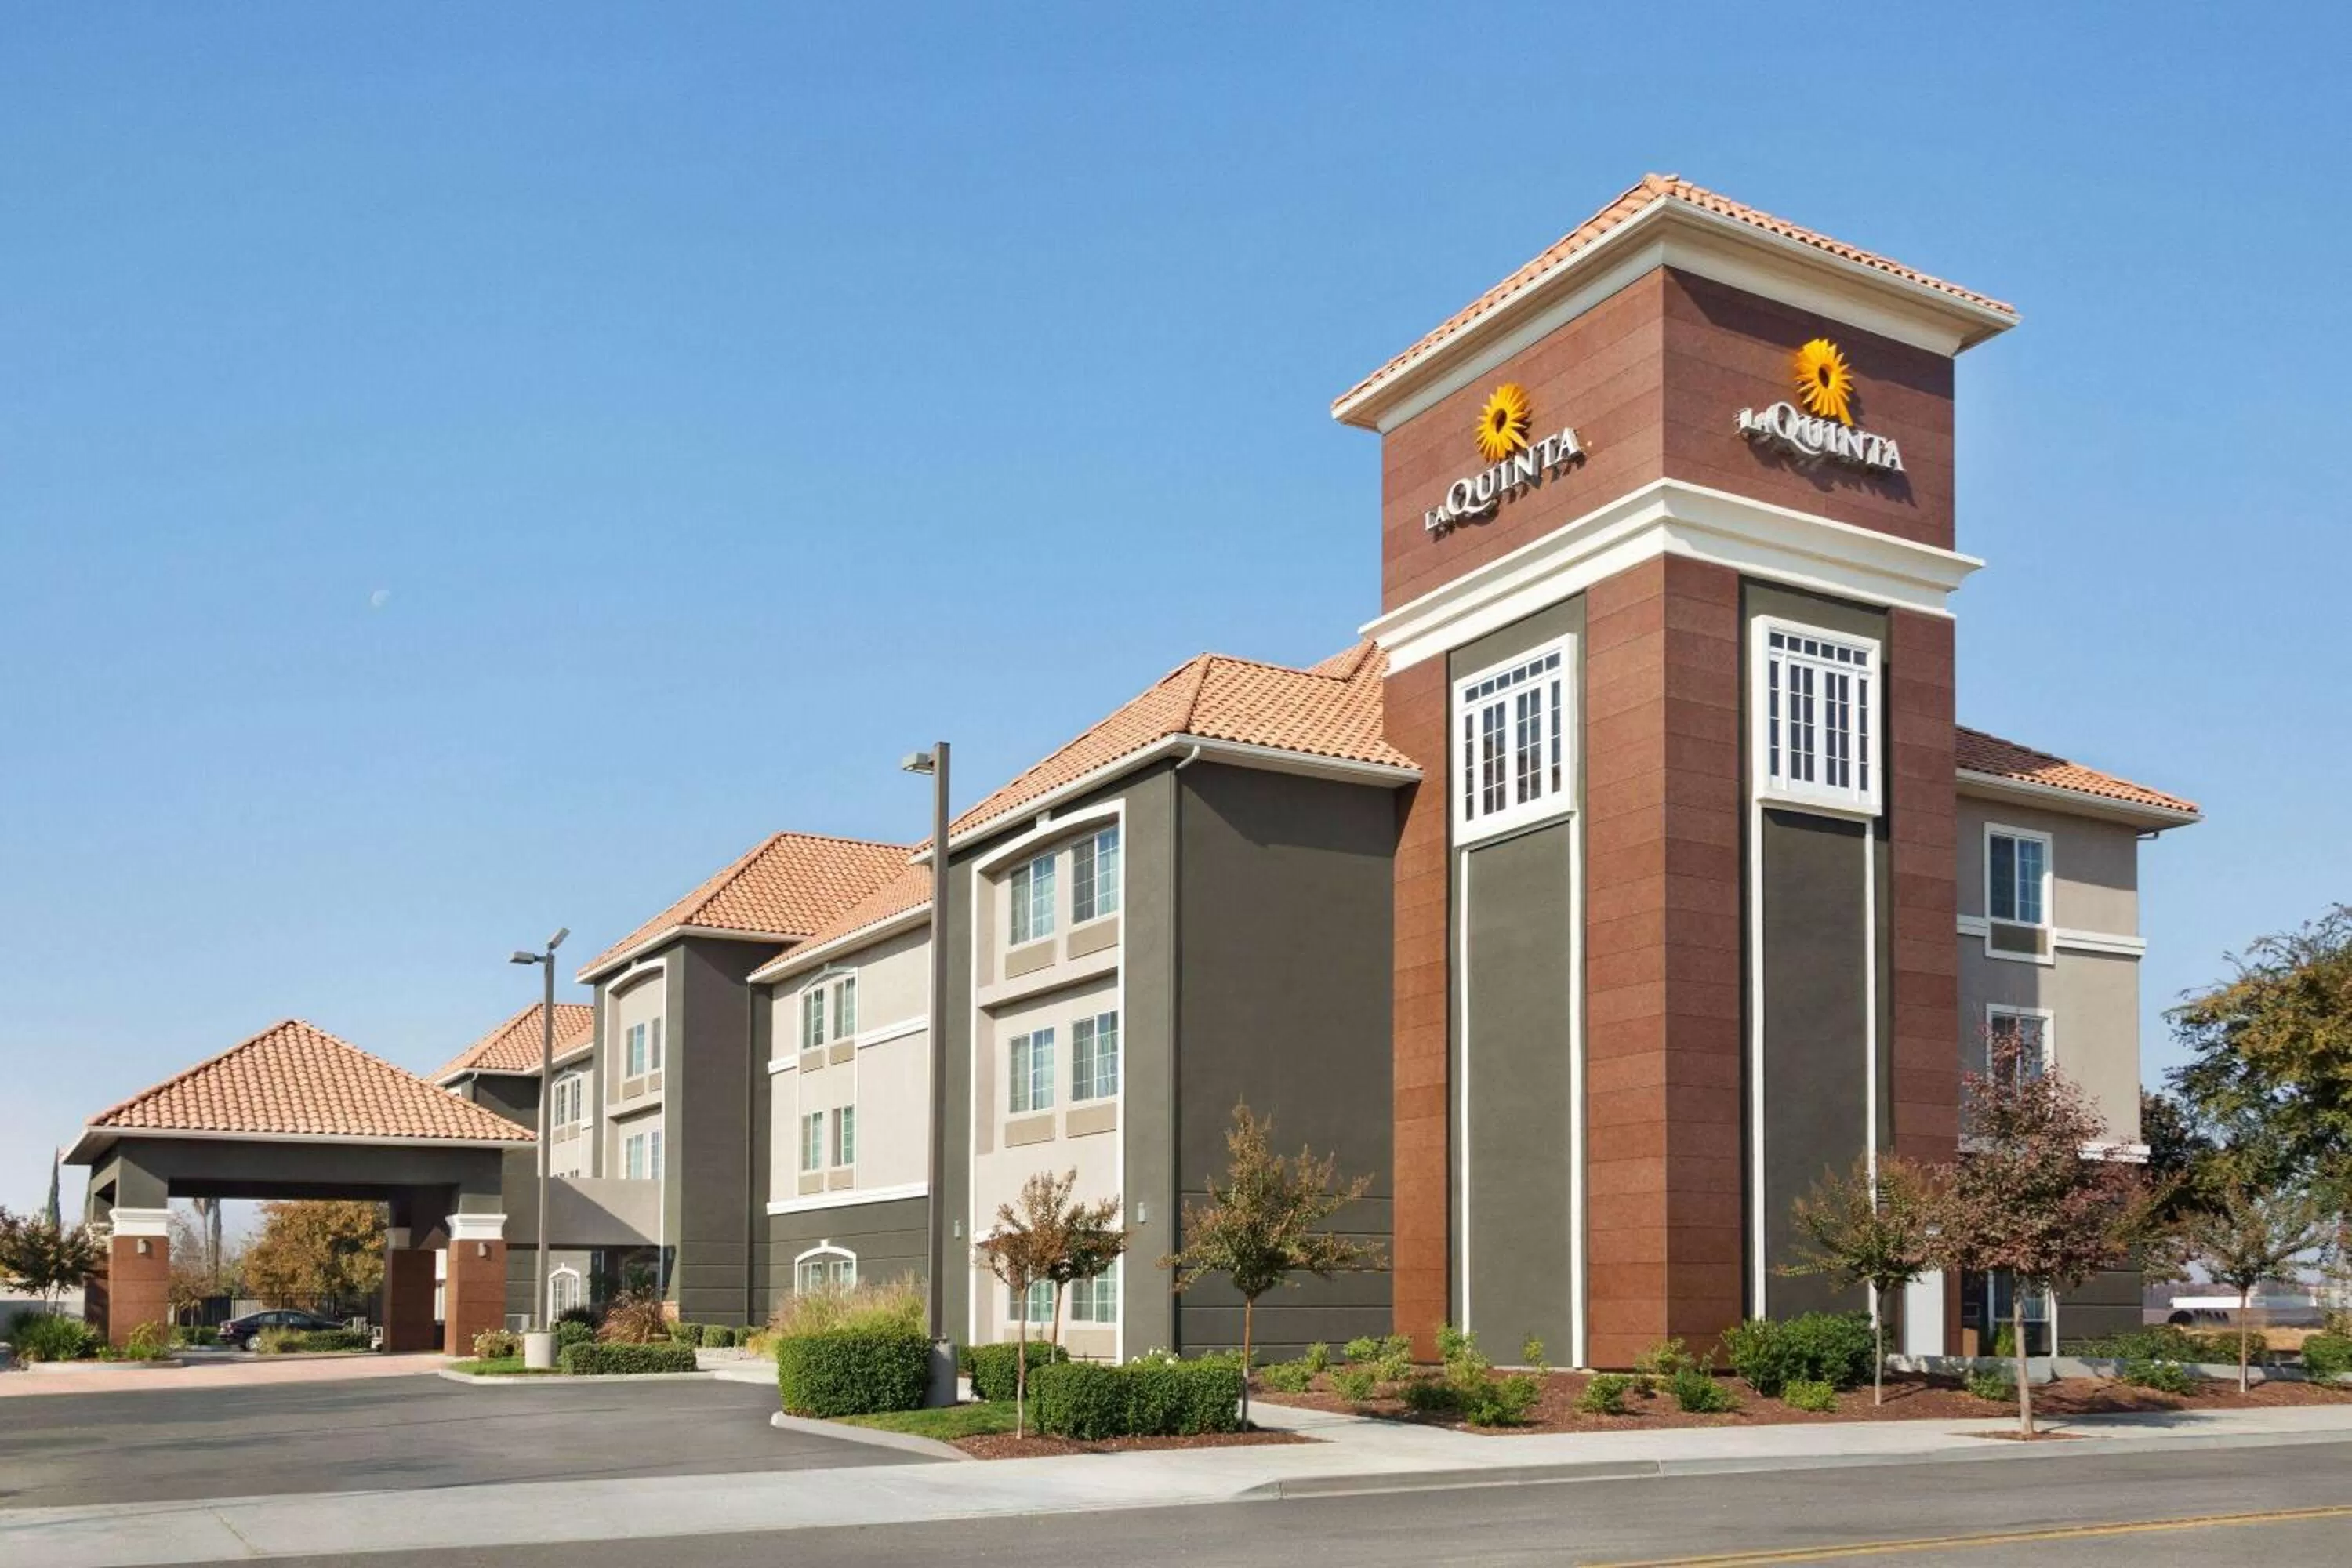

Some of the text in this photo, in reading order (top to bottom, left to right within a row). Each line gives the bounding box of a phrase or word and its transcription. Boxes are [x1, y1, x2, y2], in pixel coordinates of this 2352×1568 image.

[1425, 427, 1581, 531] LA QUINTA
[1766, 401, 1906, 472] QUINTA
